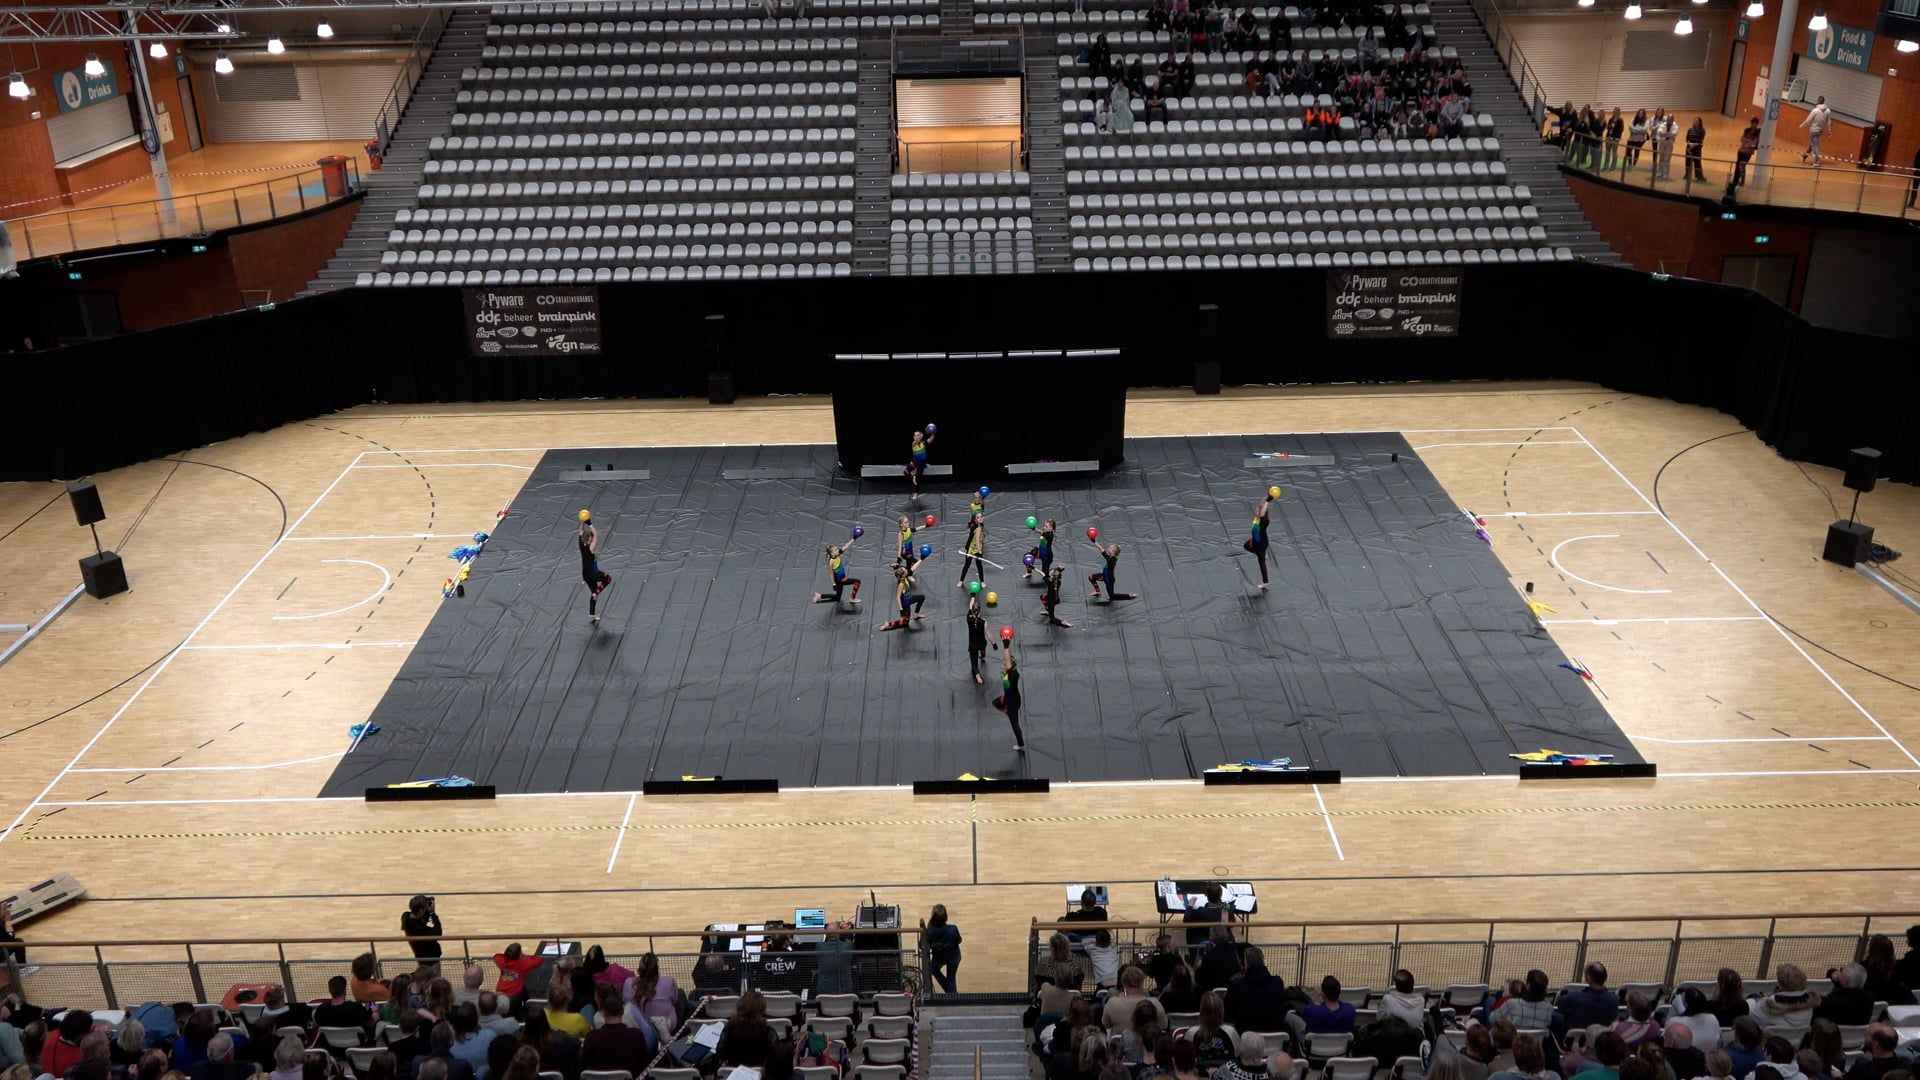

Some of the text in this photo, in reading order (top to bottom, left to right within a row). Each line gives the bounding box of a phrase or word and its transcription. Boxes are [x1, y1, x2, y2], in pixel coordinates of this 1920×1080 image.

[1841, 29, 1860, 45] Food
[1838, 48, 1862, 65] Drinks
[88, 84, 112, 100] Drinks
[1352, 275, 1387, 290] Pyware
[488, 293, 524, 309] Pyware
[1336, 292, 1393, 307] ddf beheer
[1398, 292, 1456, 304] brainpink
[476, 310, 533, 325] ddf beheer
[538, 311, 596, 322] brainpink
[1410, 323, 1431, 335] cgn
[556, 341, 577, 352] cgn
[765, 961, 797, 971] CREW
